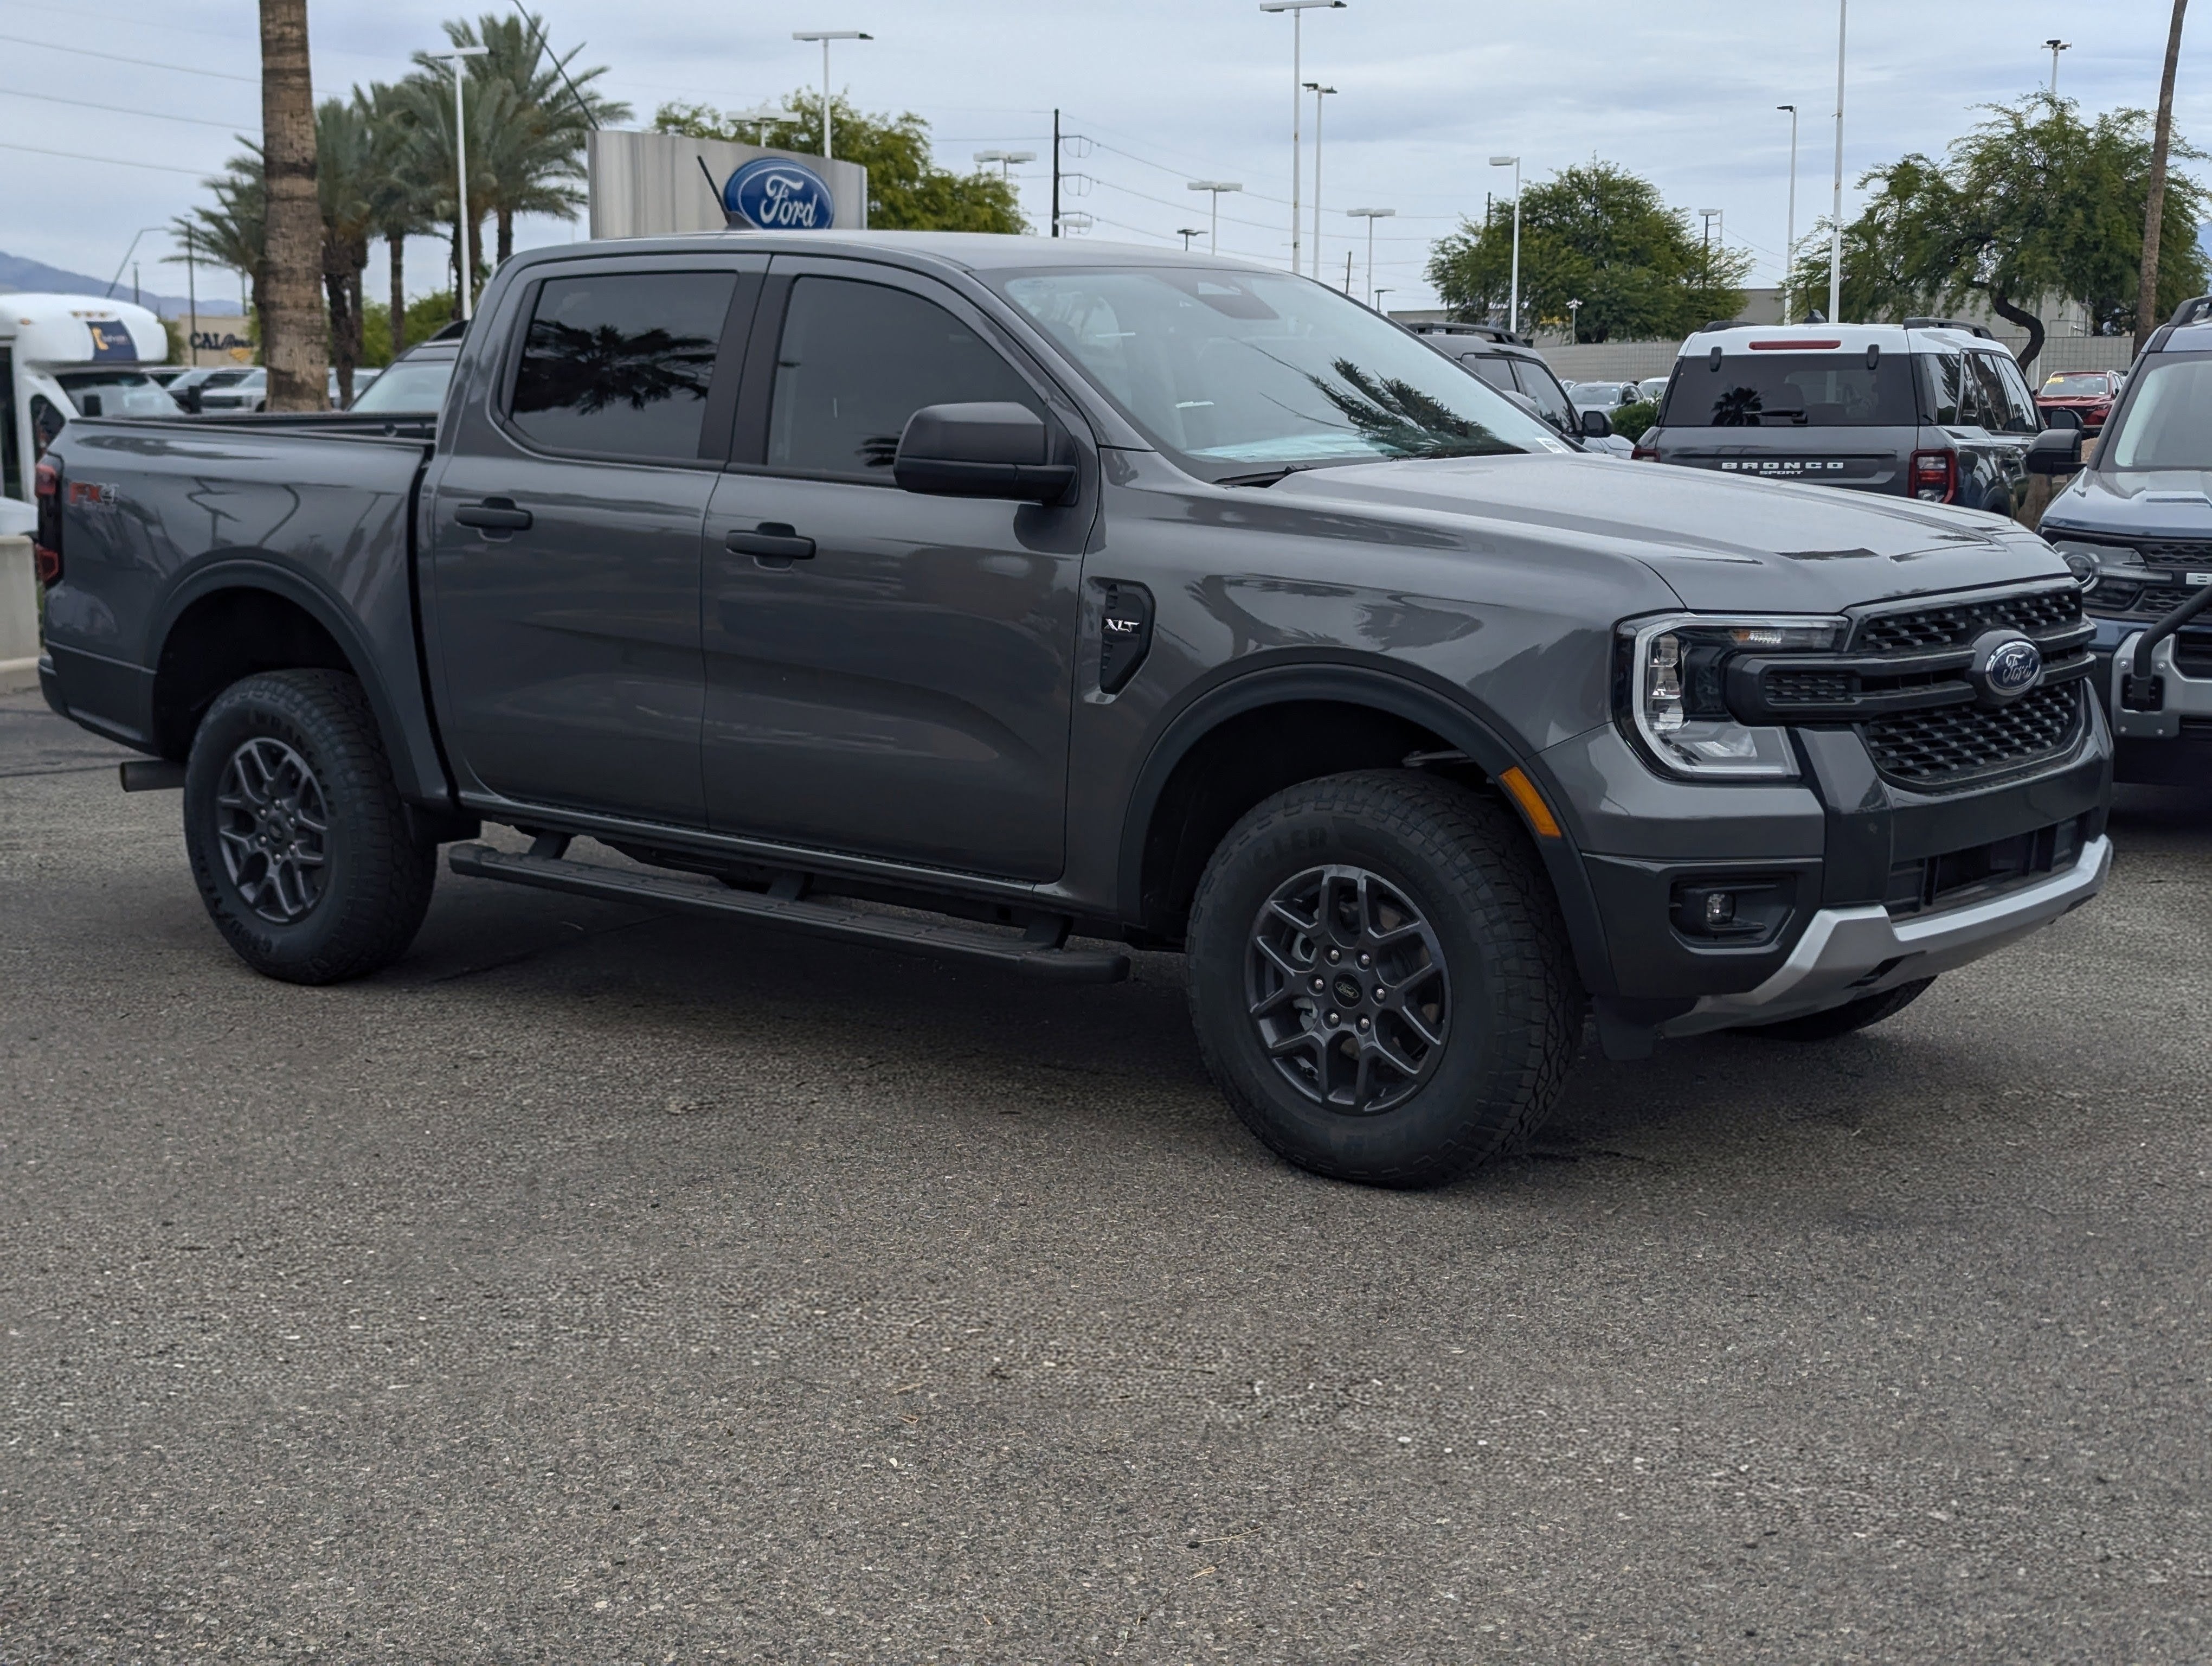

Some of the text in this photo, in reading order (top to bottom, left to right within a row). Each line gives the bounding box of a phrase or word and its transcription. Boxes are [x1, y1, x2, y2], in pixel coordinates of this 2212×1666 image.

[760, 175, 818, 227] Ford
[69, 482, 120, 505] FX4
[1104, 618, 1140, 633] XLT
[2002, 653, 2033, 684] Ford
